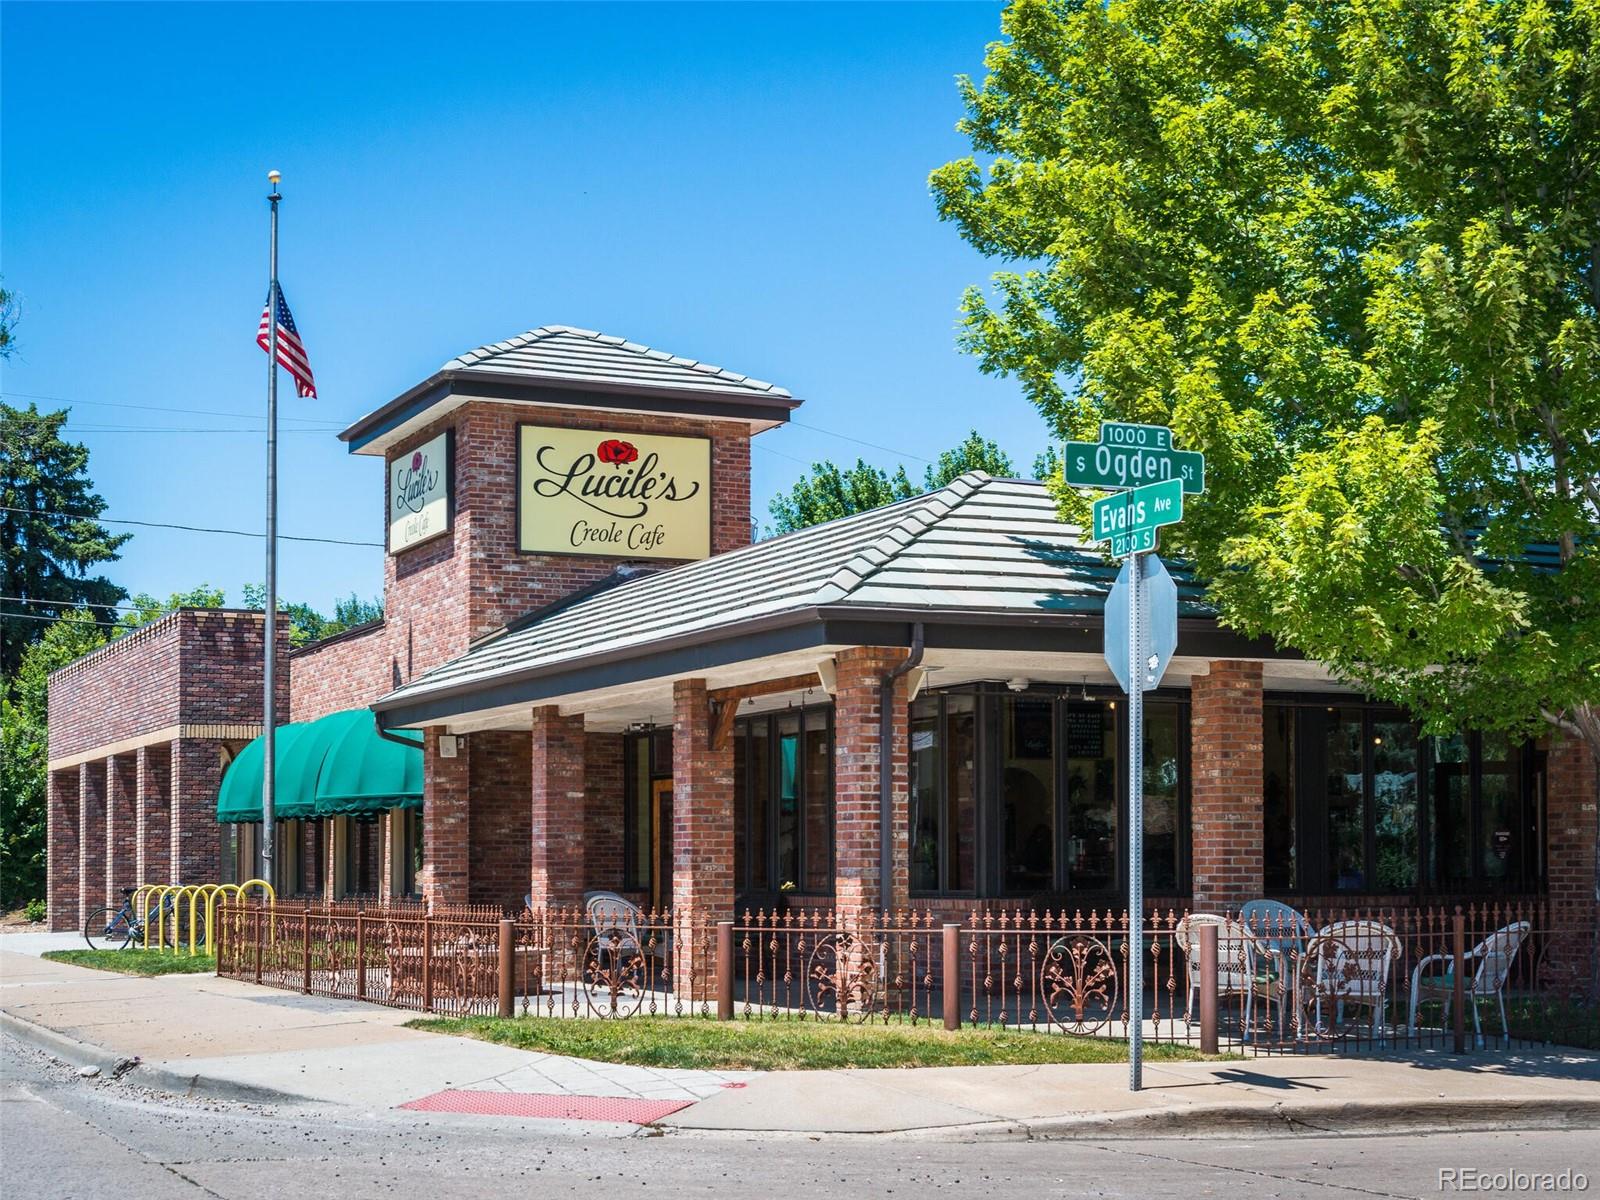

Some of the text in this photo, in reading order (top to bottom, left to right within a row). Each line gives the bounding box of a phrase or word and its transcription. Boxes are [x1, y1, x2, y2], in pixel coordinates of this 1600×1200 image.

[1108, 427, 1166, 447] 1000 E
[1076, 445, 1194, 486] S Ogden St
[534, 446, 700, 519] Lucile's
[1101, 497, 1172, 534] Evans Ave
[570, 520, 665, 550] Creole Cafe
[1115, 531, 1151, 554] 2100 S
